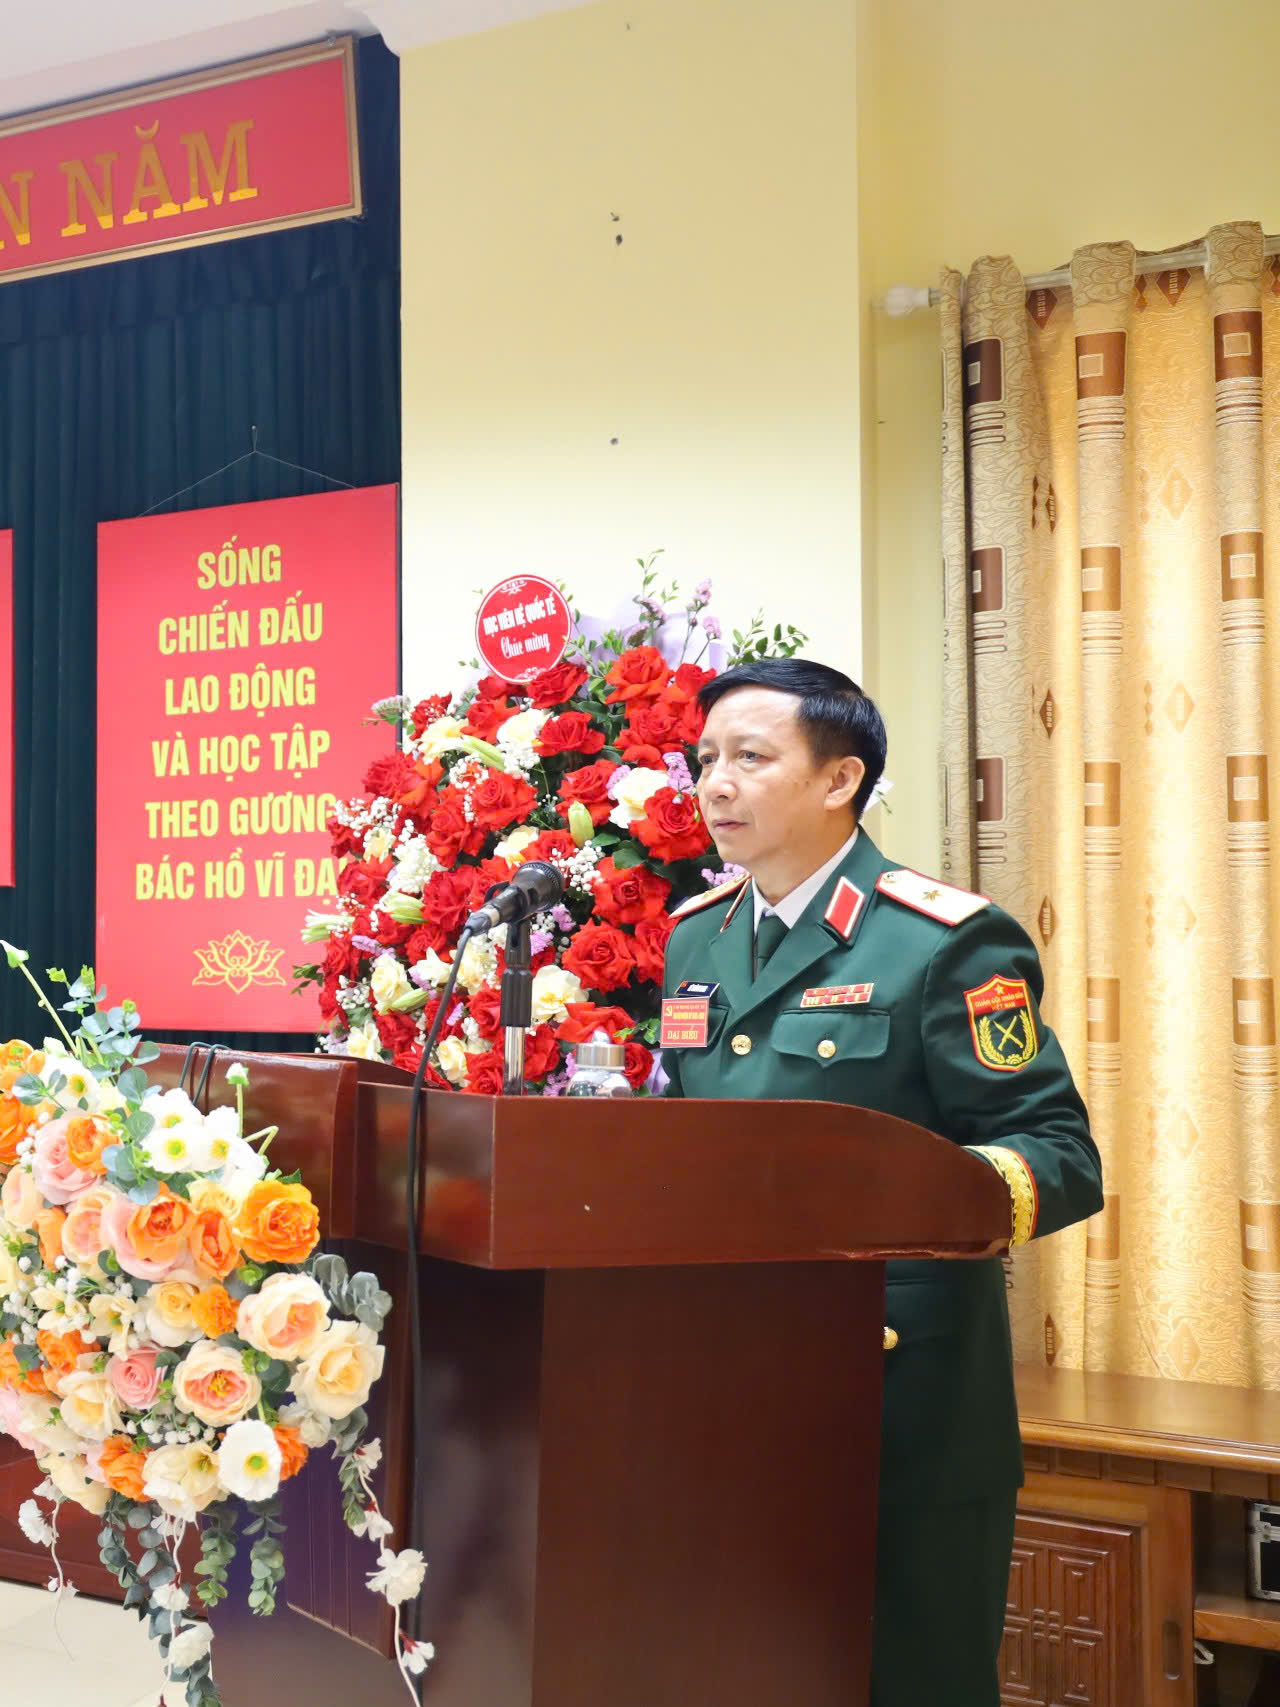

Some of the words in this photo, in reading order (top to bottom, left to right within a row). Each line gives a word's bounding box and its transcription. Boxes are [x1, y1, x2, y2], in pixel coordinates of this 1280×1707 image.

[59, 119, 258, 237] NĂM
[197, 536, 282, 589] SỐNG
[158, 599, 250, 655] CHIẾN
[258, 591, 324, 645] ĐẤU
[165, 675, 220, 716] LAO
[229, 663, 317, 718] ĐỘNG
[151, 732, 190, 777] VÀ
[199, 734, 261, 781] HỌC
[270, 723, 331, 779] TẬP
[144, 799, 220, 839] THEO
[229, 791, 337, 836] GƯƠNG
[135, 854, 195, 901] BÁC
[204, 847, 245, 899] HỒ
[255, 852, 284, 898] VĨ
